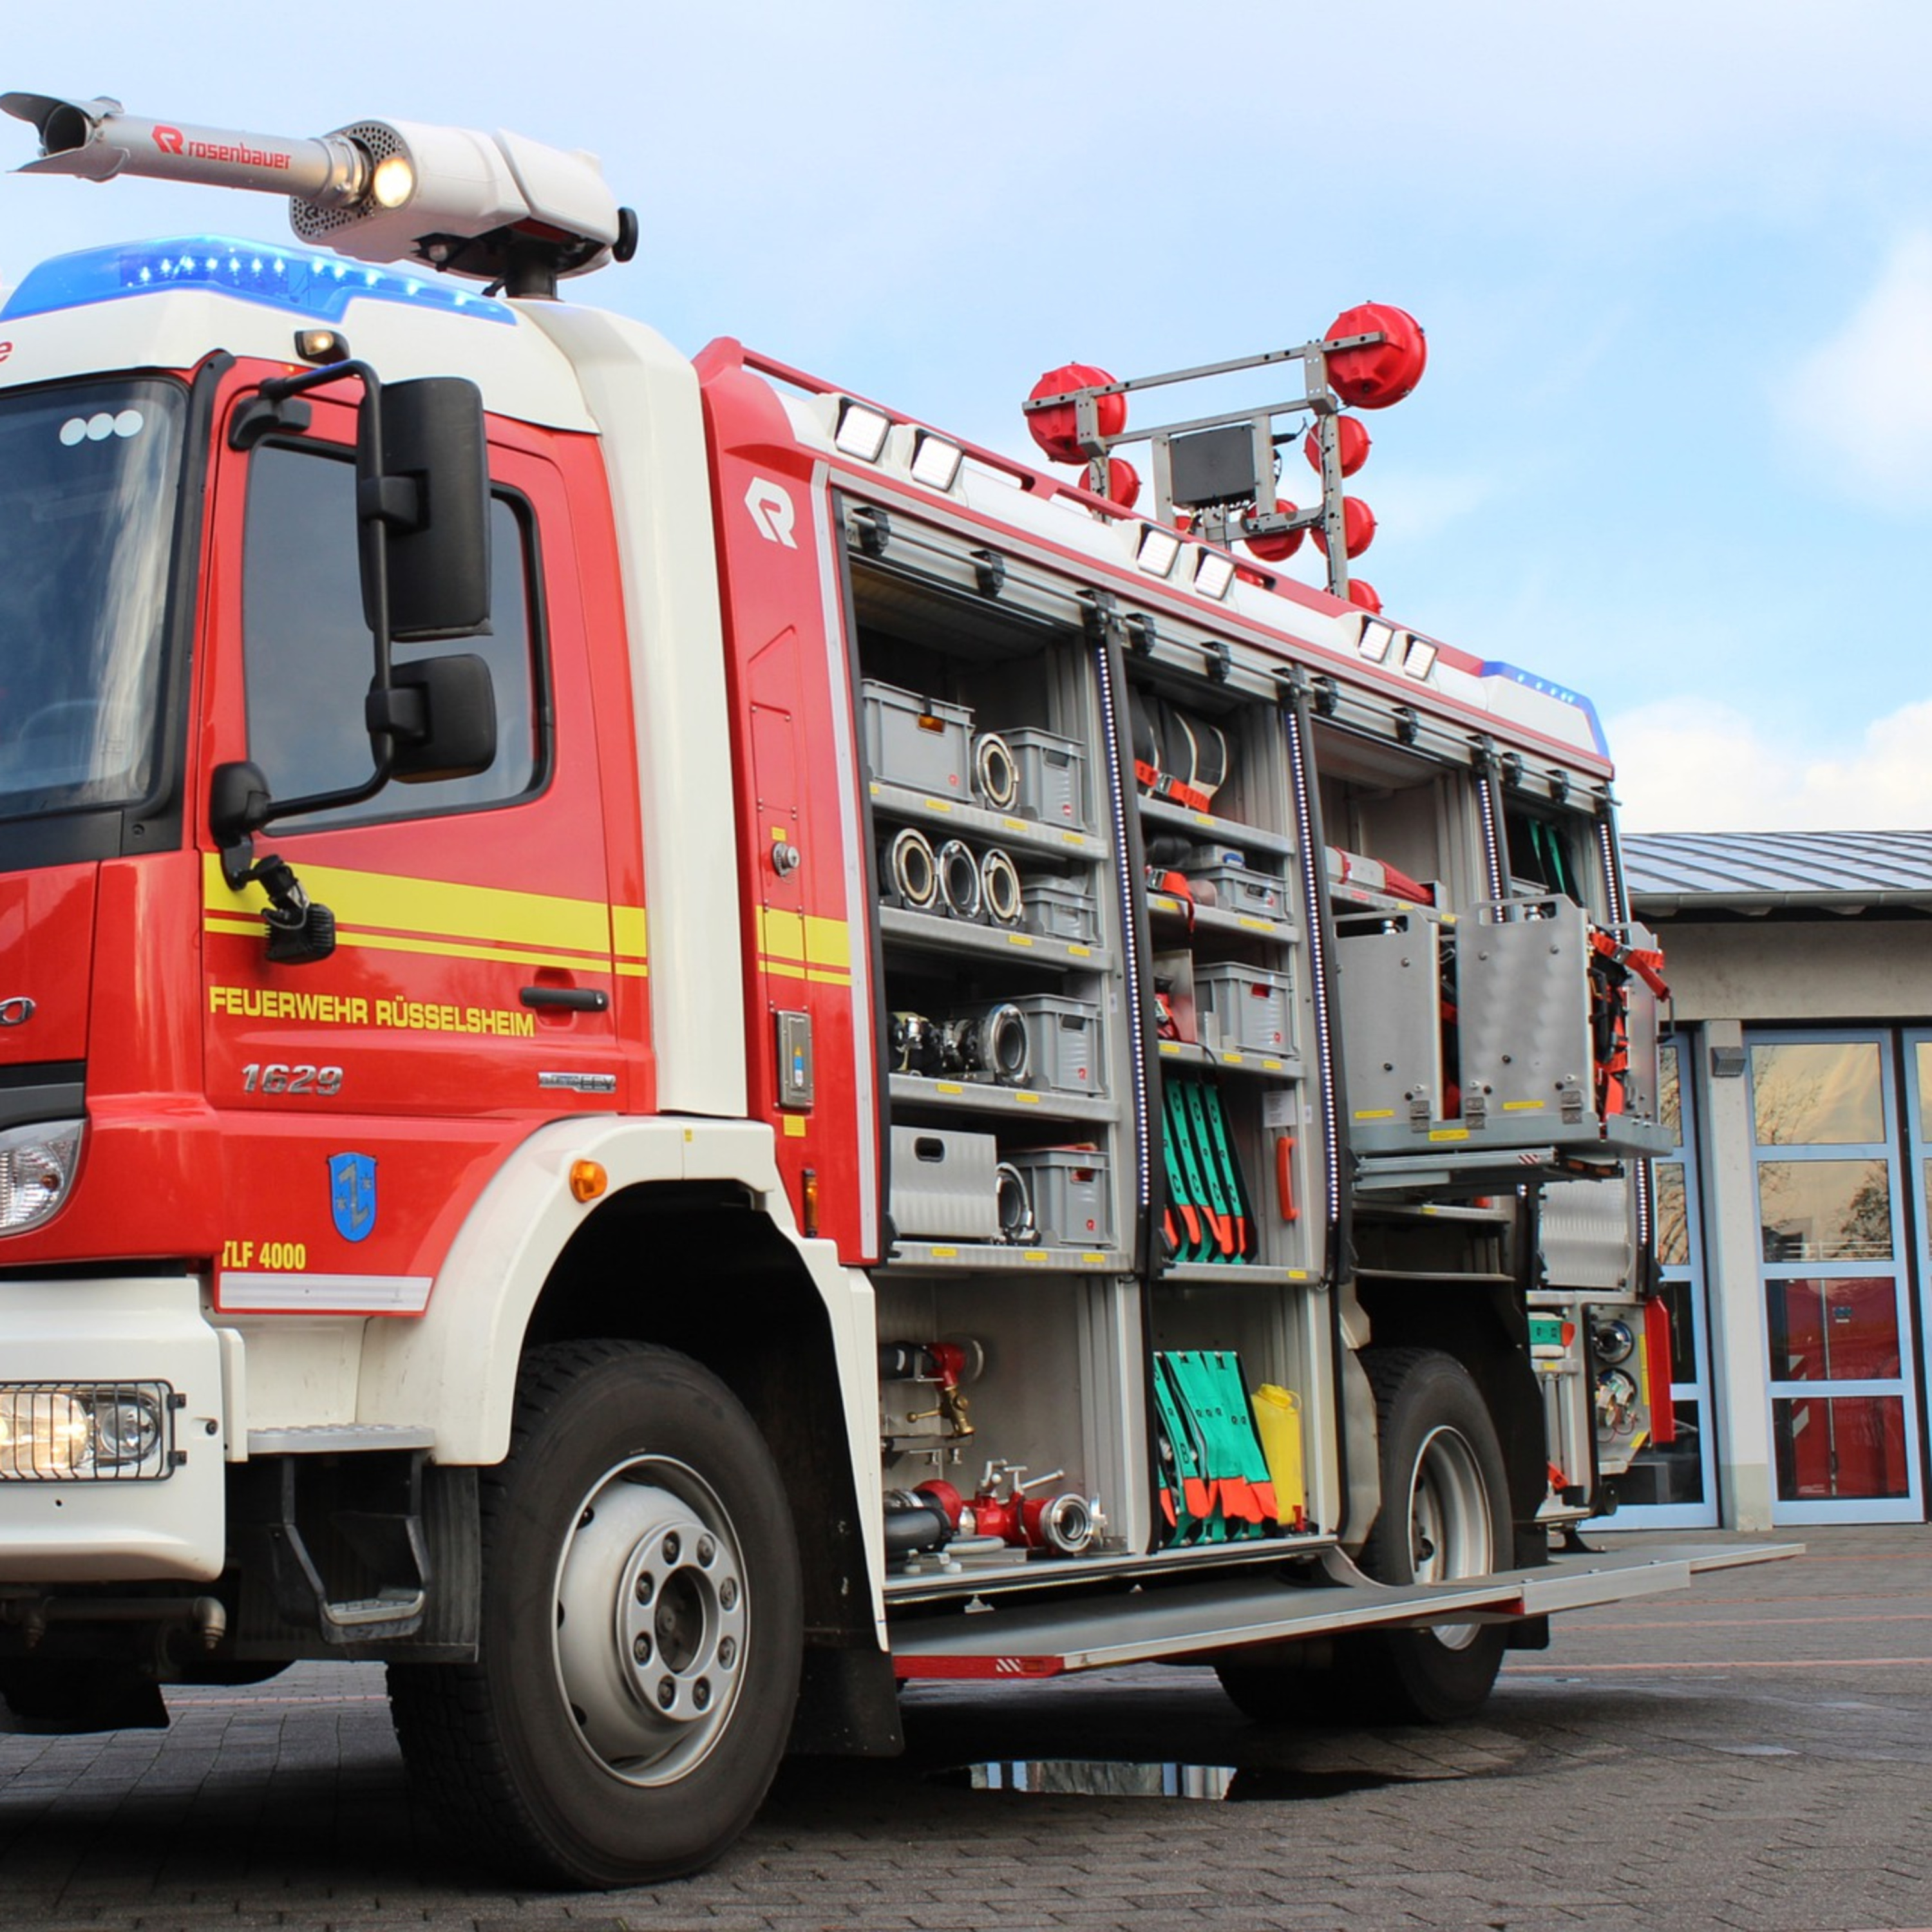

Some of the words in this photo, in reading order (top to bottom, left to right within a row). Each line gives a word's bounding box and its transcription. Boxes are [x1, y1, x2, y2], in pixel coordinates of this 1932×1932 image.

[189, 141, 291, 169] rosenbauer
[209, 986, 368, 1024] FEUERWEHR
[375, 995, 534, 1037] RÜSSELSHEIM
[242, 1063, 343, 1095] 1629
[222, 1241, 254, 1267] TLF
[259, 1242, 306, 1270] 4000
